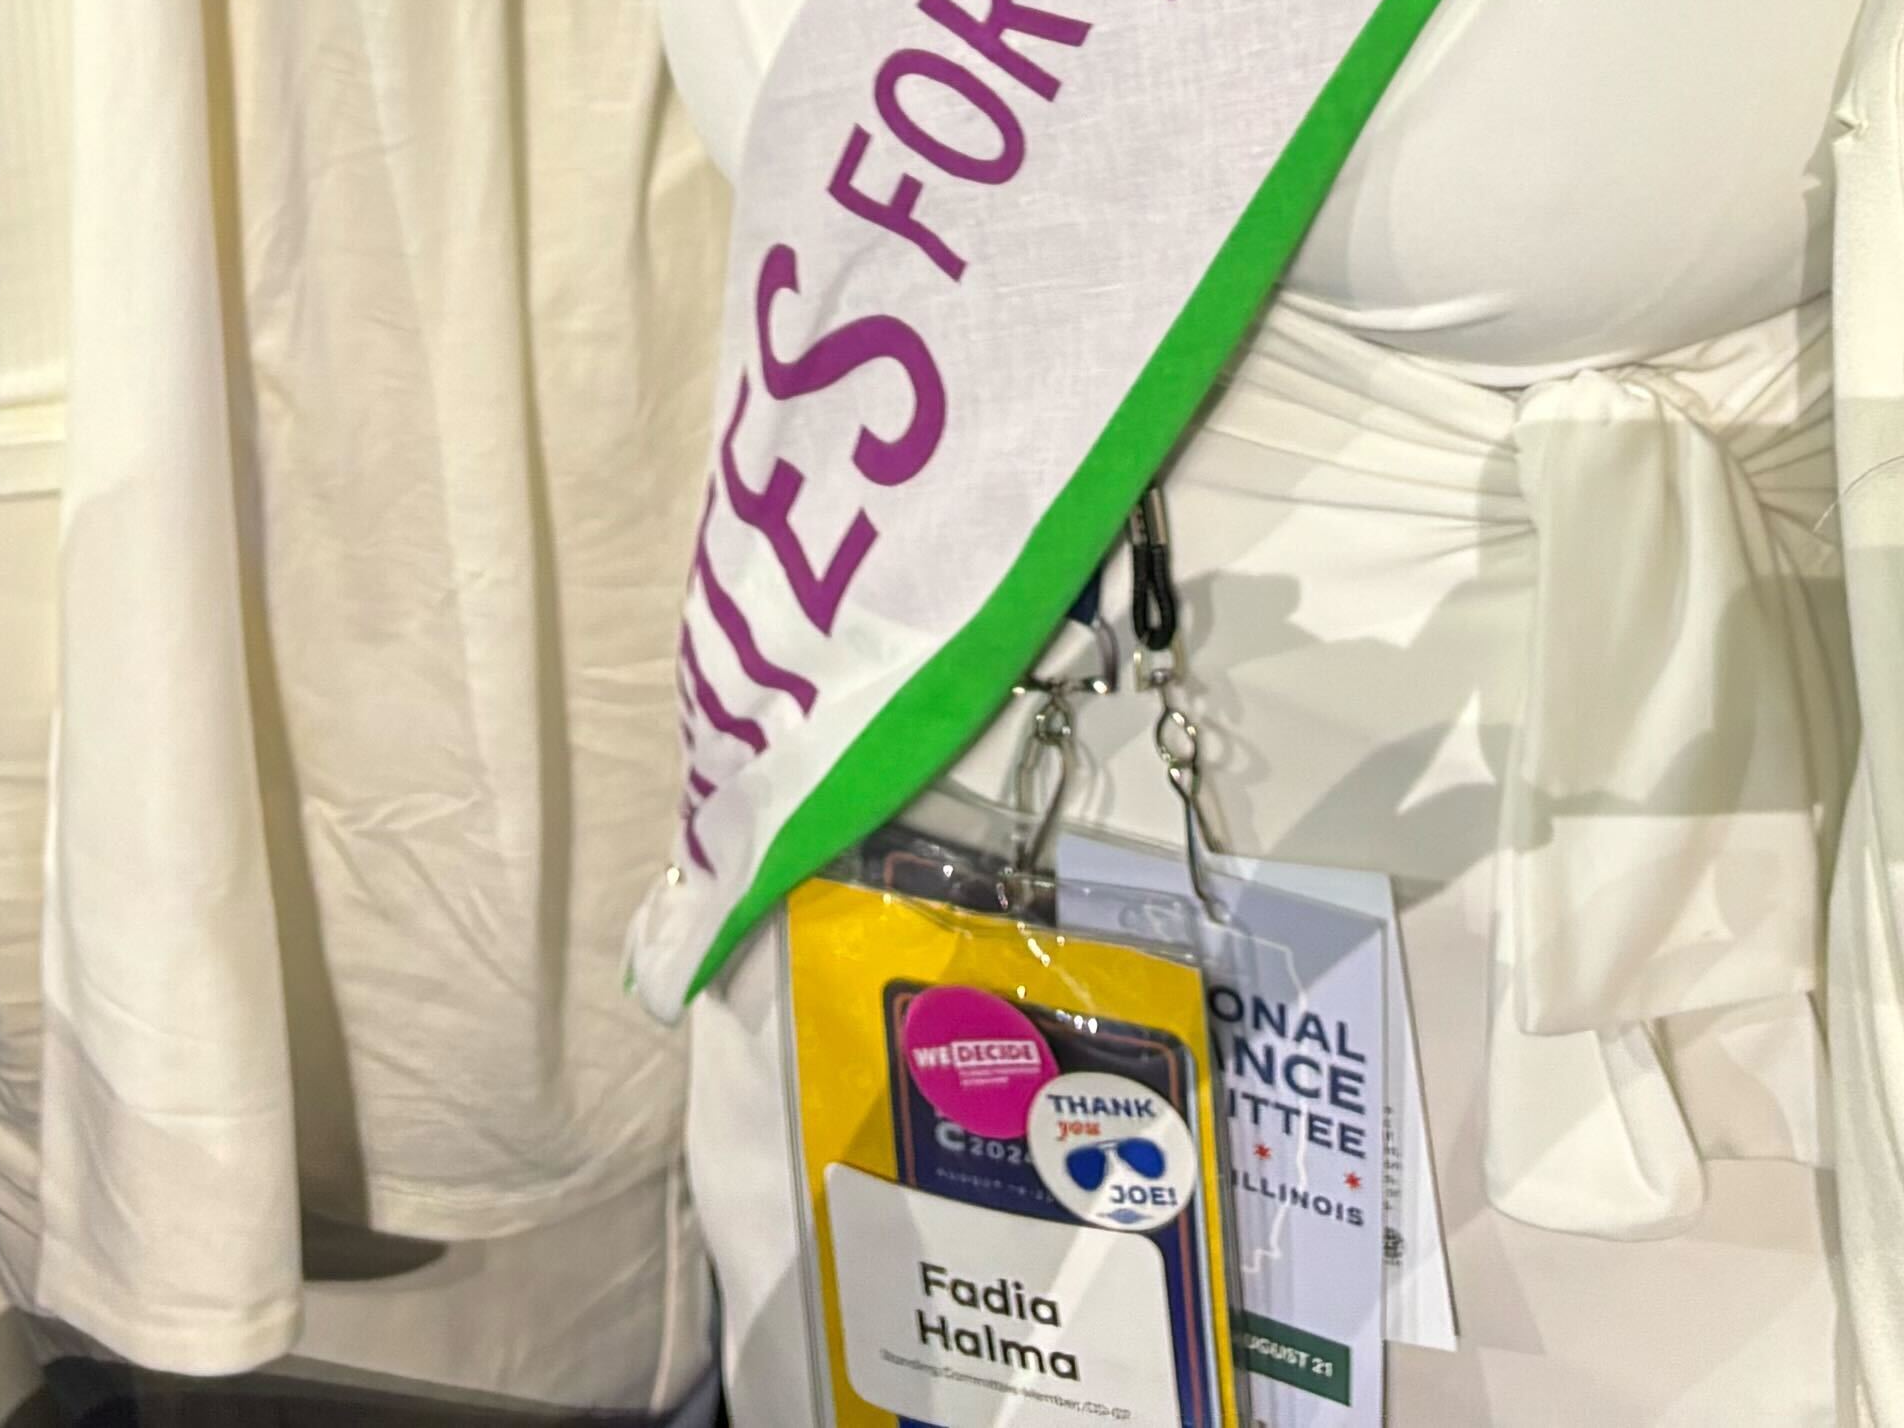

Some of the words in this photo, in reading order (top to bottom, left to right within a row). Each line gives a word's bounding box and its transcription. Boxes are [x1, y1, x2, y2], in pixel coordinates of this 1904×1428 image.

[912, 1047, 953, 1069] WE
[957, 1042, 1038, 1063] DECIDE
[1047, 1093, 1157, 1119] THANK
[1056, 1119, 1102, 1142] you
[1110, 1184, 1180, 1207] JOE!
[918, 1260, 1063, 1328] Fadia
[915, 1308, 1081, 1382] Halma
